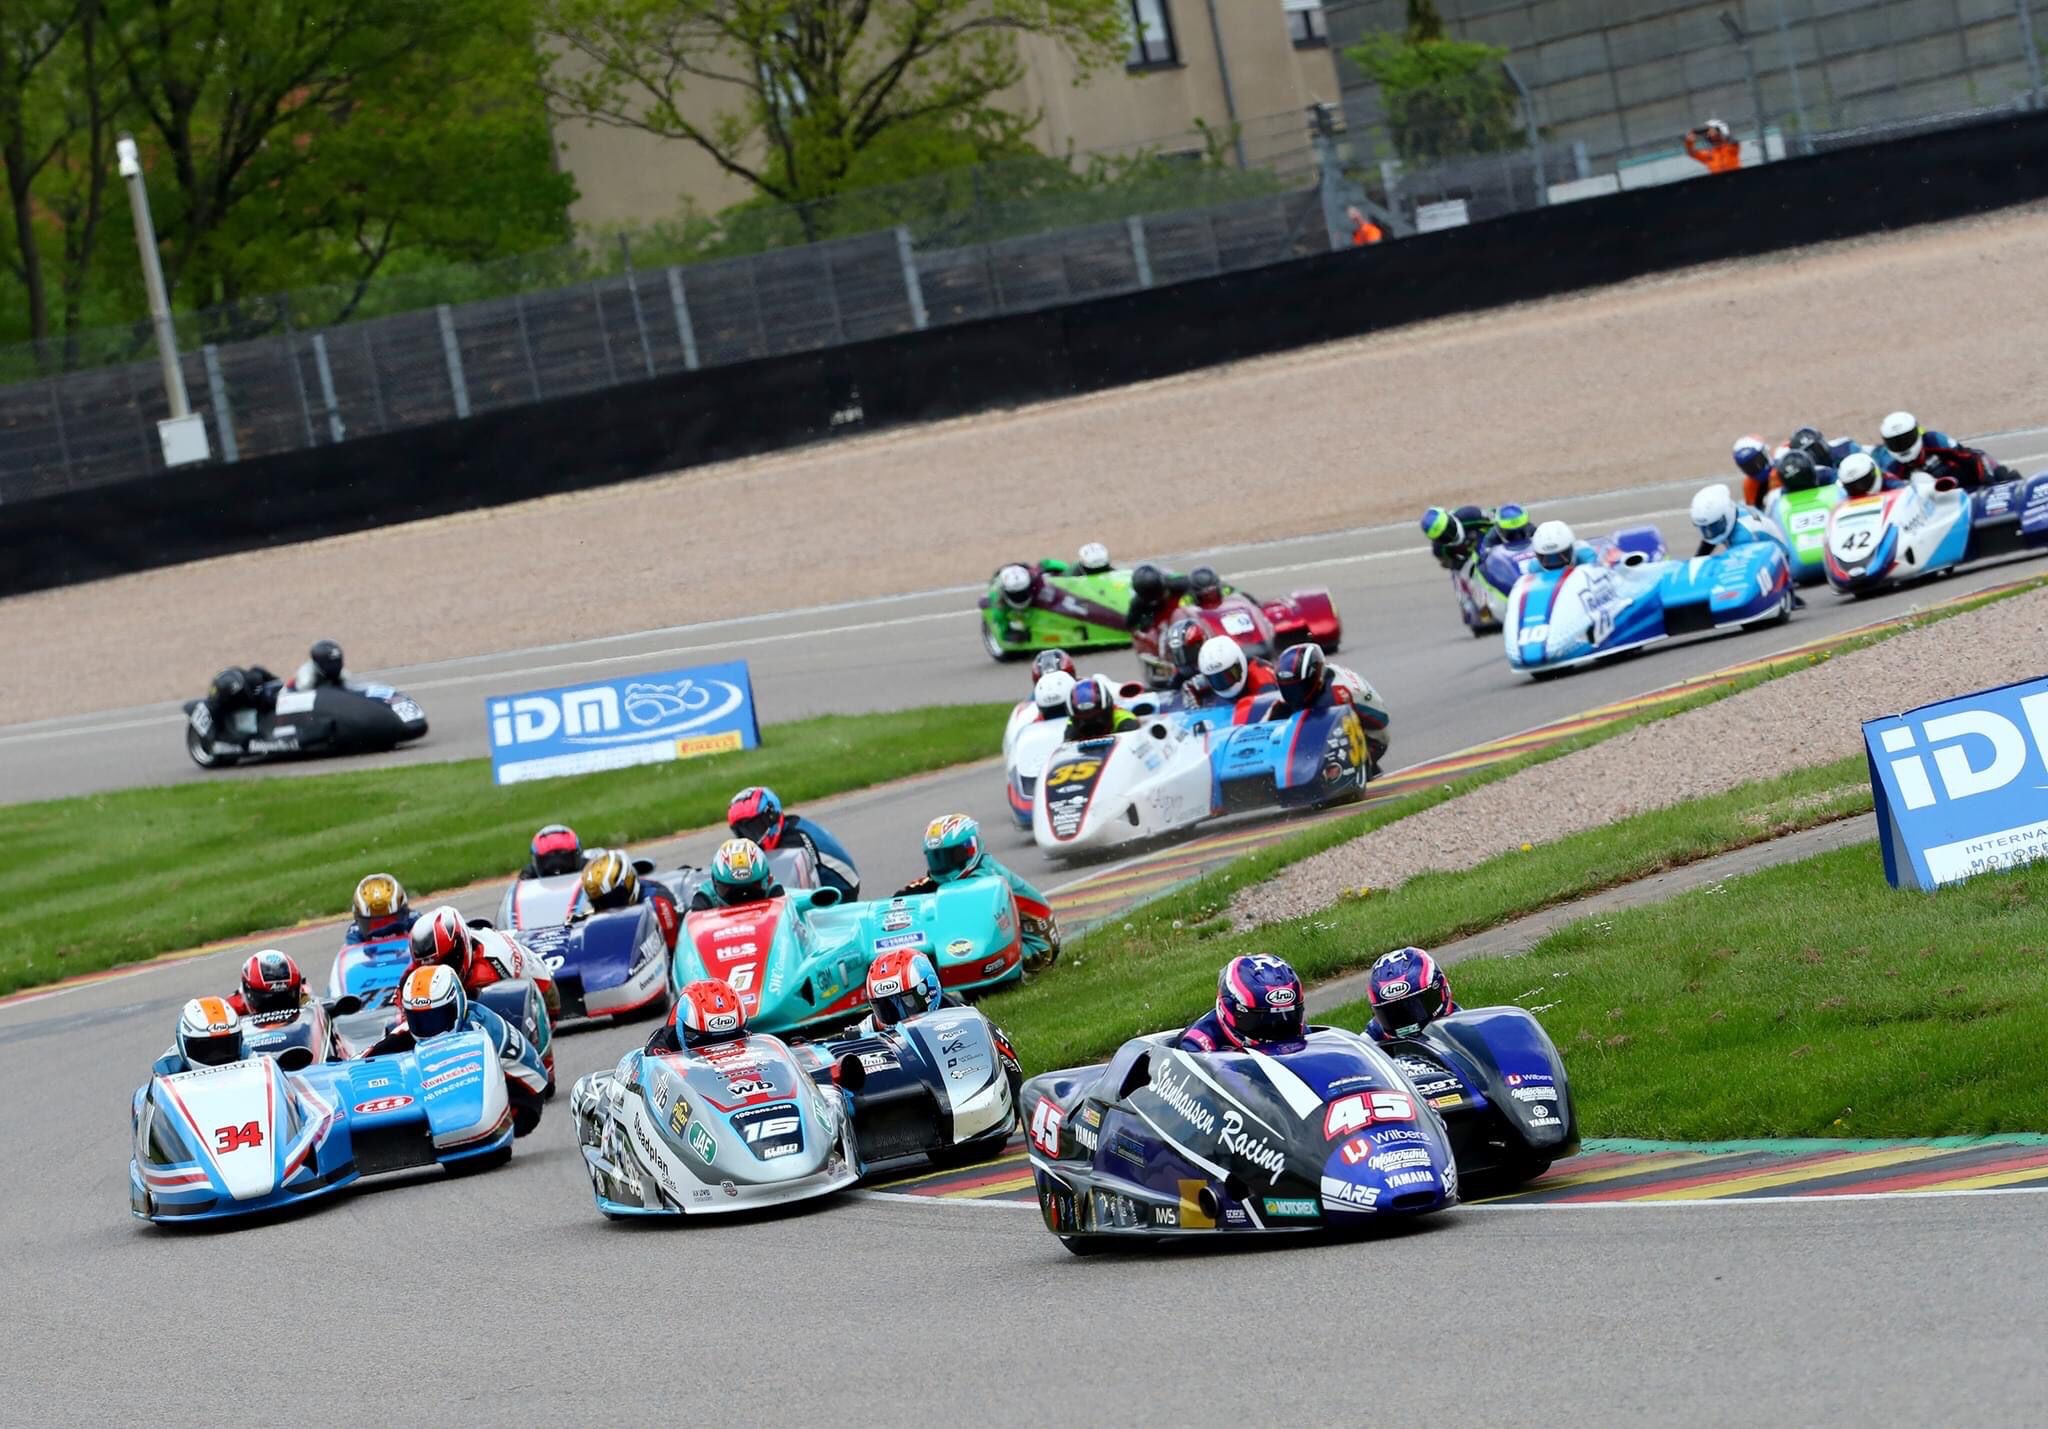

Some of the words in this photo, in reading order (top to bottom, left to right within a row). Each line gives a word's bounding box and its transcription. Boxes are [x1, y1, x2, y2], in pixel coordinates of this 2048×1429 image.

[1842, 531, 1871, 550] 42
[1047, 760, 1101, 786] 35
[876, 981, 898, 994] Arai
[1267, 989, 1294, 1004] Arai
[1383, 982, 1407, 998] Arai
[207, 1023, 232, 1033] Arai
[709, 1017, 734, 1029] Arai
[1149, 1058, 1214, 1135] Steinhausen
[1218, 1110, 1285, 1186] Racing
[1326, 1090, 1416, 1139] 45
[1528, 1116, 1561, 1128] YAMAHA
[743, 1116, 800, 1144] 16
[1030, 1096, 1064, 1159] 45
[1370, 1129, 1431, 1145] Wilbers
[215, 1121, 264, 1155] 34
[1385, 1170, 1434, 1189] YAMAHA
[1340, 1182, 1382, 1206] ARS
[1276, 1200, 1316, 1216] MOTOREX
